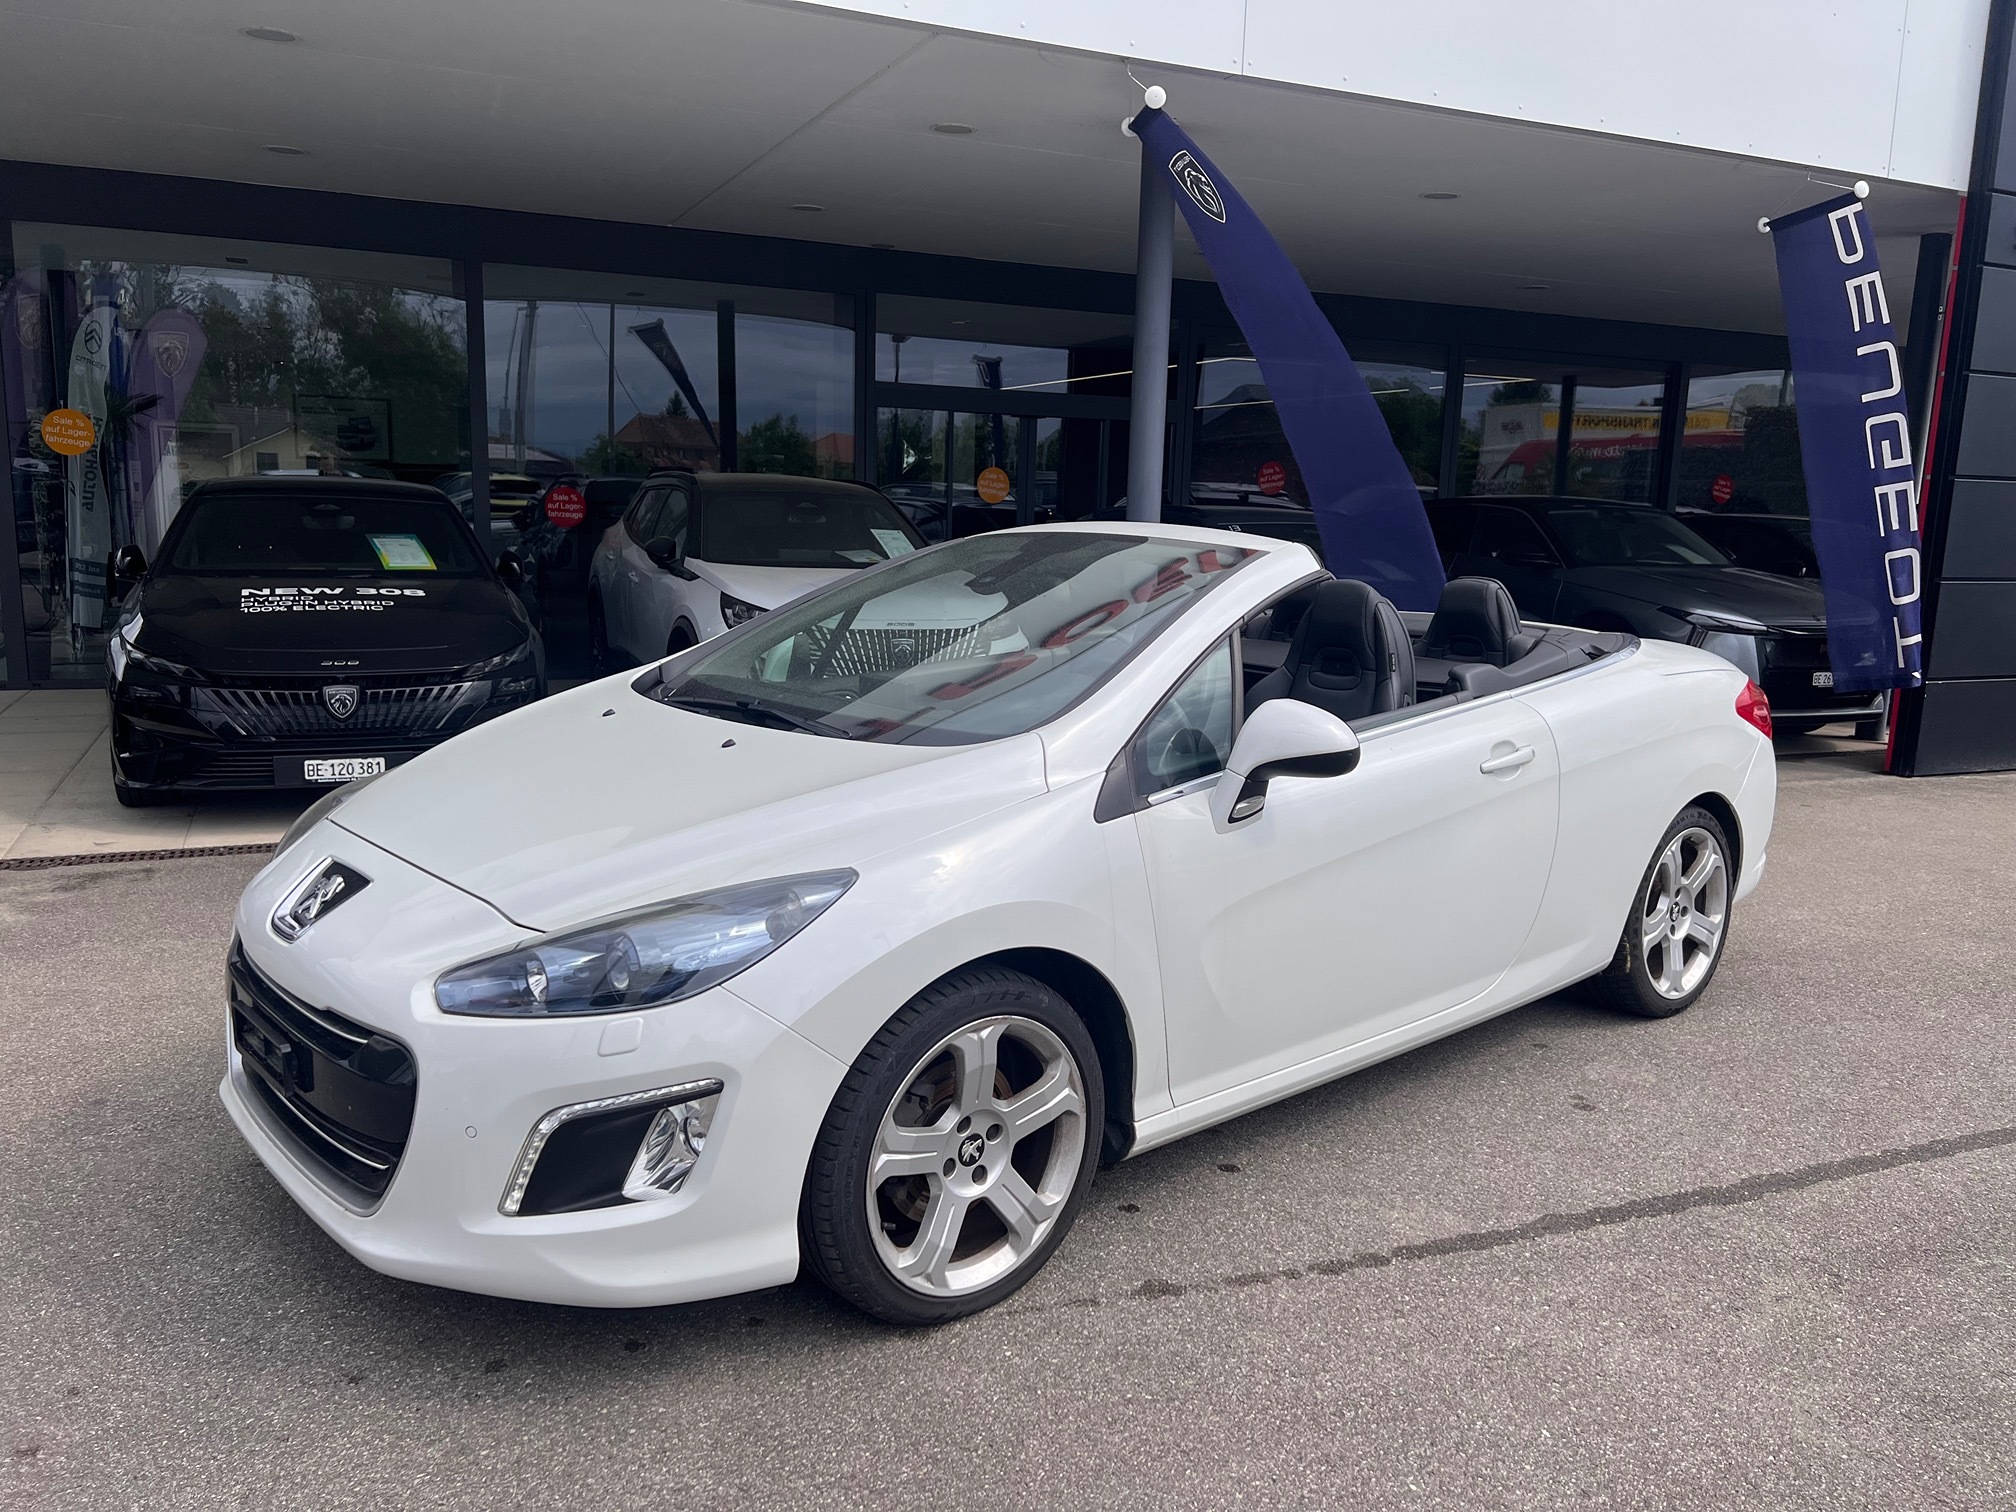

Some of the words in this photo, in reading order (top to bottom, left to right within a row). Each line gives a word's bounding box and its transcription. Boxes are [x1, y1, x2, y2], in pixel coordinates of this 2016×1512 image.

[53, 415, 73, 425] Sale
[75, 418, 85, 427] %
[45, 425, 60, 433] auf
[62, 427, 91, 437] Lager-
[45, 434, 90, 447] fahrzeuge
[552, 493, 569, 501] Sale
[560, 502, 583, 511] Lager-
[548, 510, 583, 519] fahrzeuge
[241, 587, 344, 596] NEW
[355, 588, 426, 597] 308
[241, 600, 318, 608] PLUG-IN
[240, 605, 288, 613] 100%
[357, 761, 382, 775] 381
